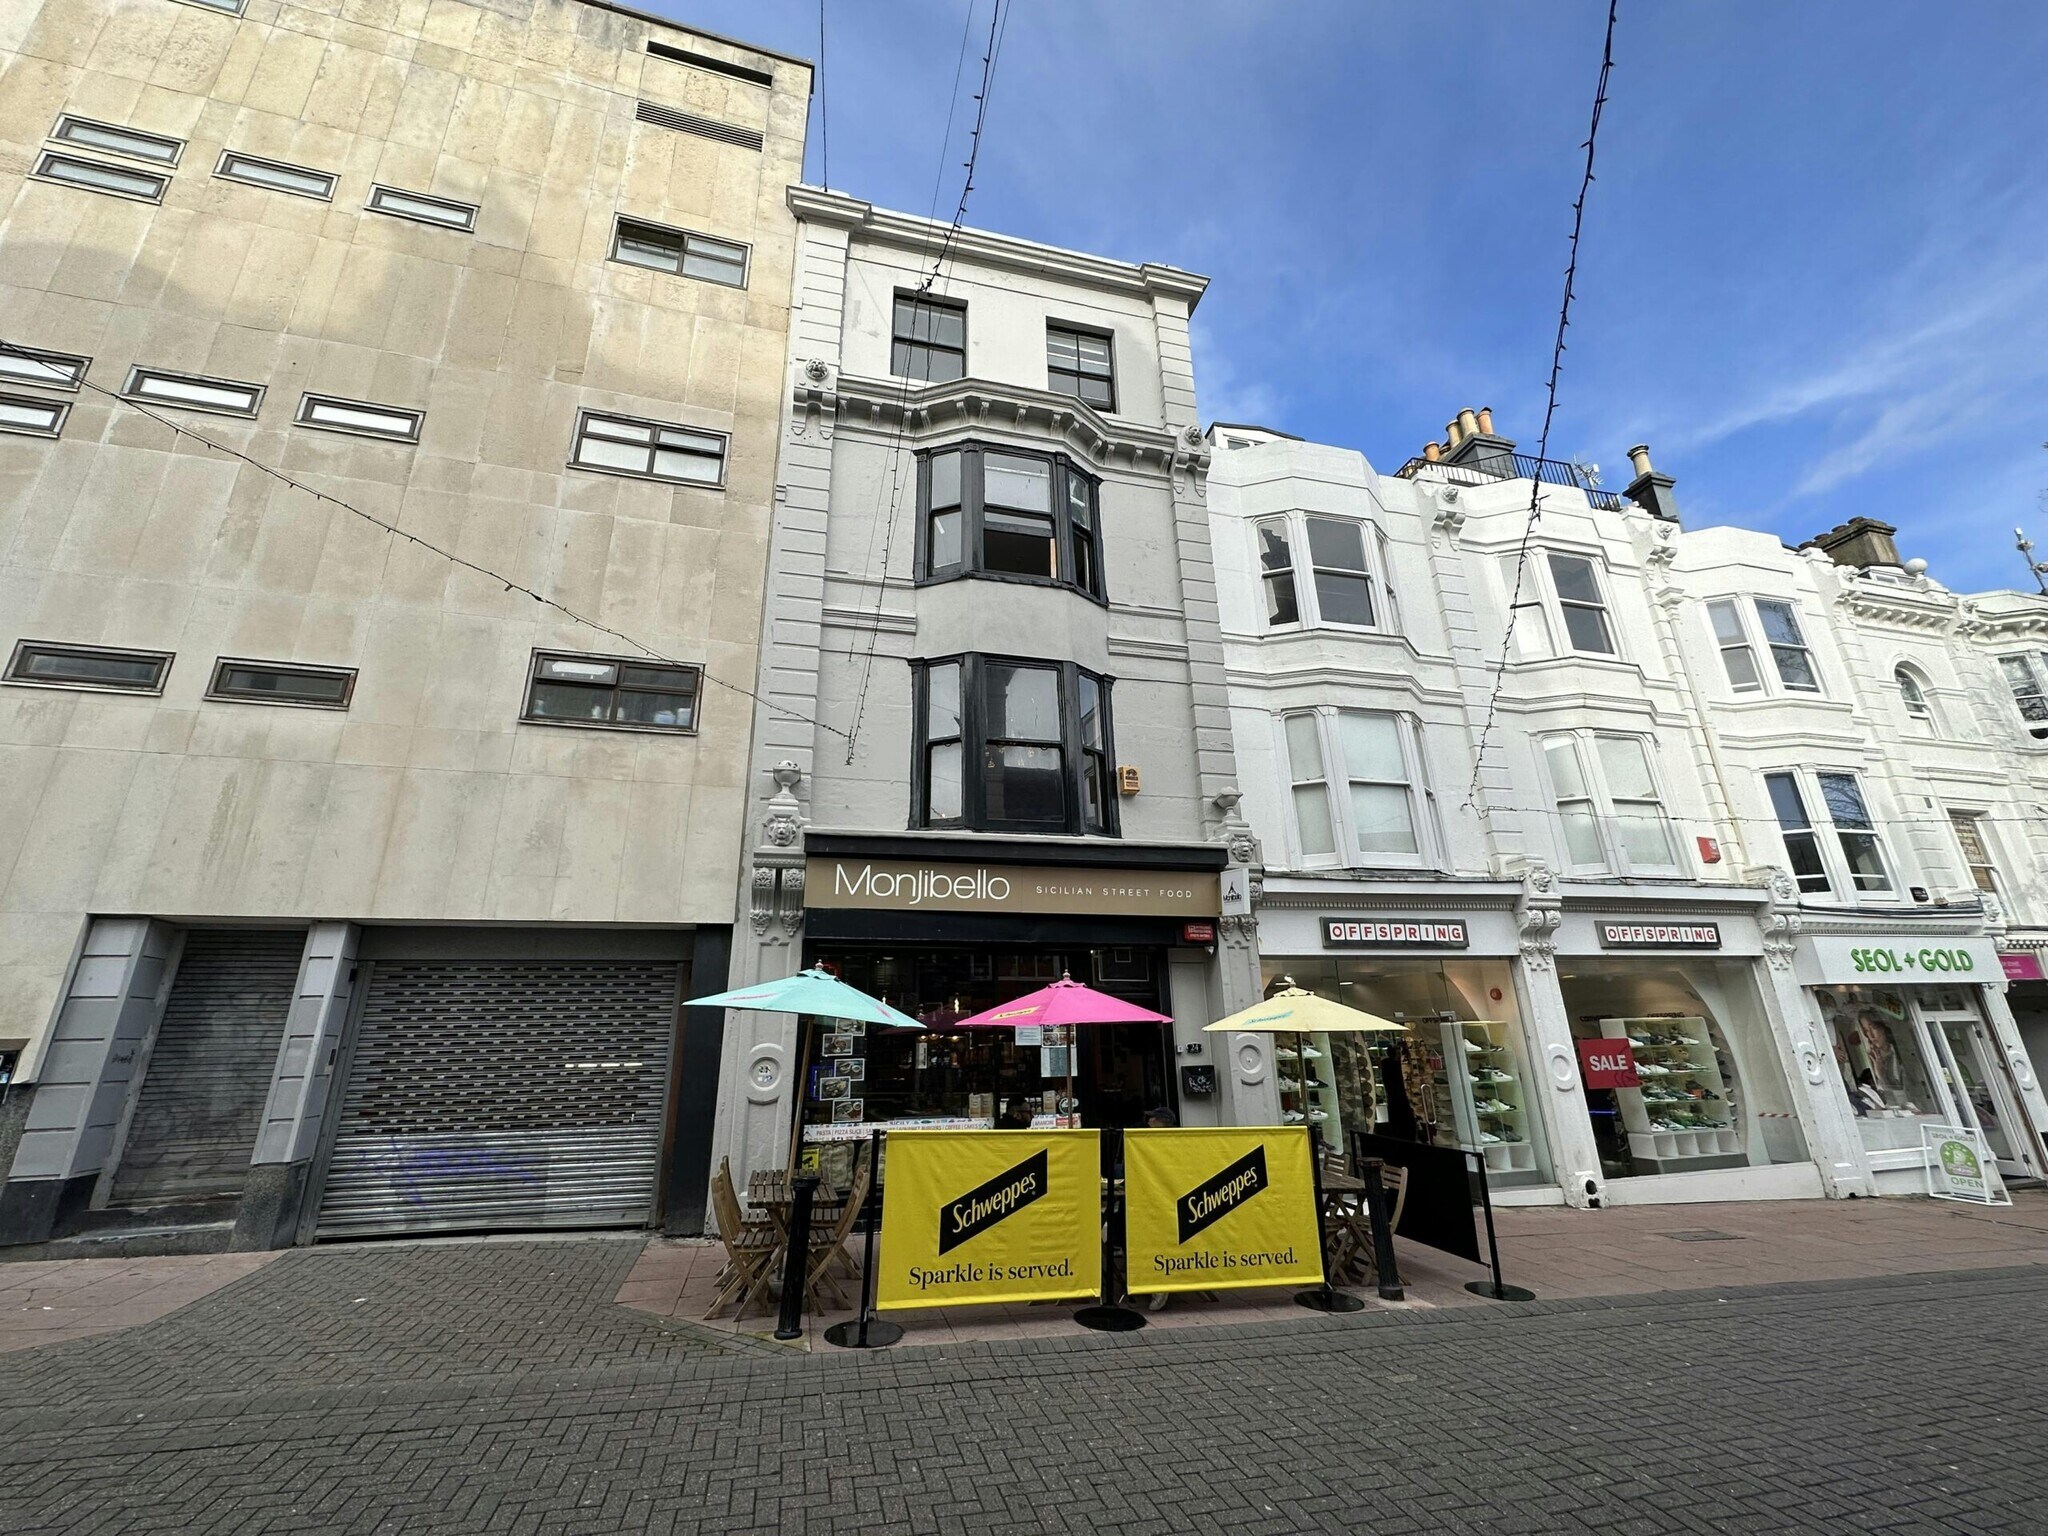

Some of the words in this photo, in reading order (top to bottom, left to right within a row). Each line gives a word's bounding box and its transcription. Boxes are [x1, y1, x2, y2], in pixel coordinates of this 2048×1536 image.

[1035, 885, 1093, 896] SICILIAN
[1102, 887, 1150, 897] STREET
[1159, 889, 1193, 898] FOOD
[1332, 925, 1461, 939] OFFSPRING
[1607, 928, 1715, 940] OFFSPRING
[1850, 948, 1903, 972] SEOL
[1918, 948, 1974, 972] GOLD
[1589, 1055, 1629, 1072] SALE
[1951, 1177, 1984, 1189] OPEN
[952, 1172, 1036, 1233] Schweppes
[1188, 1166, 1258, 1224] Schweppes
[1154, 1251, 1219, 1275] Sparkle
[1223, 1250, 1237, 1268] is
[1240, 1247, 1298, 1267] served.
[908, 1263, 983, 1290] Sparkle
[988, 1262, 1003, 1281] is
[1007, 1258, 1074, 1280] served.
